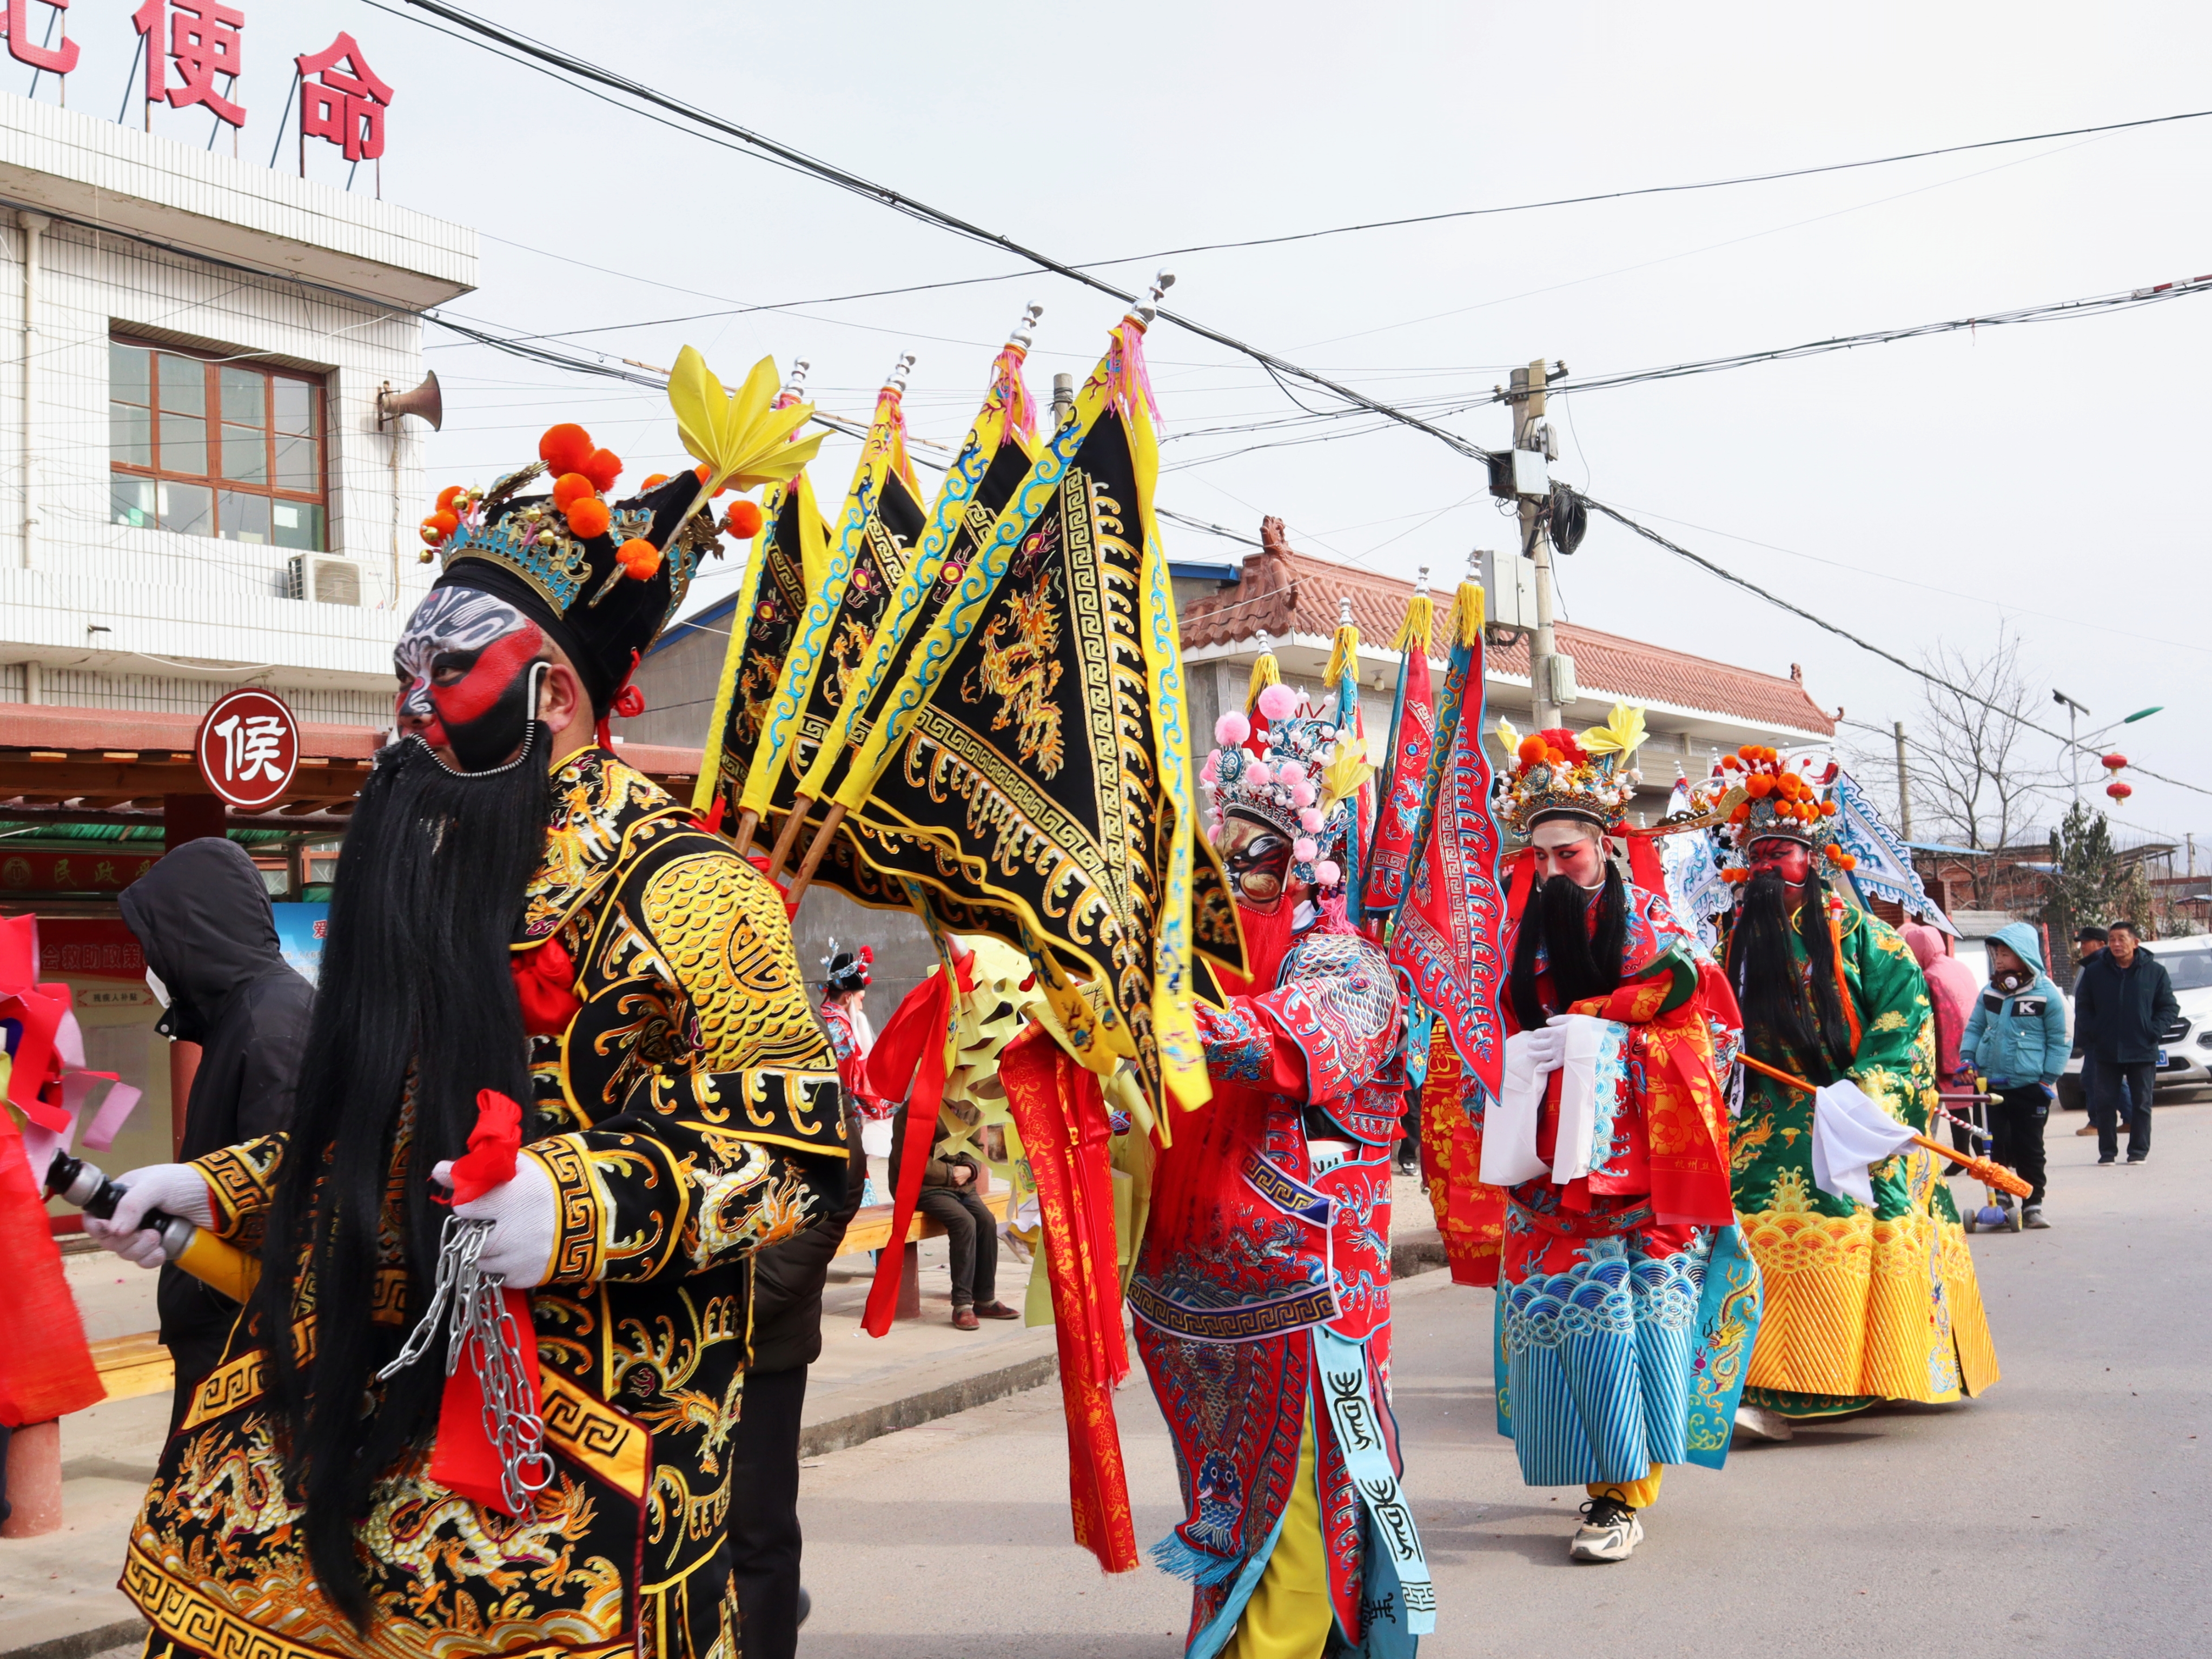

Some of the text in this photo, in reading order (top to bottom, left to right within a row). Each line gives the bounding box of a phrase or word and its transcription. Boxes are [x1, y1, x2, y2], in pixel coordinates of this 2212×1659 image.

[213, 715, 287, 782] 候
[41, 943, 147, 970] 会救助政策
[93, 993, 137, 1002] 残疾人补贴
